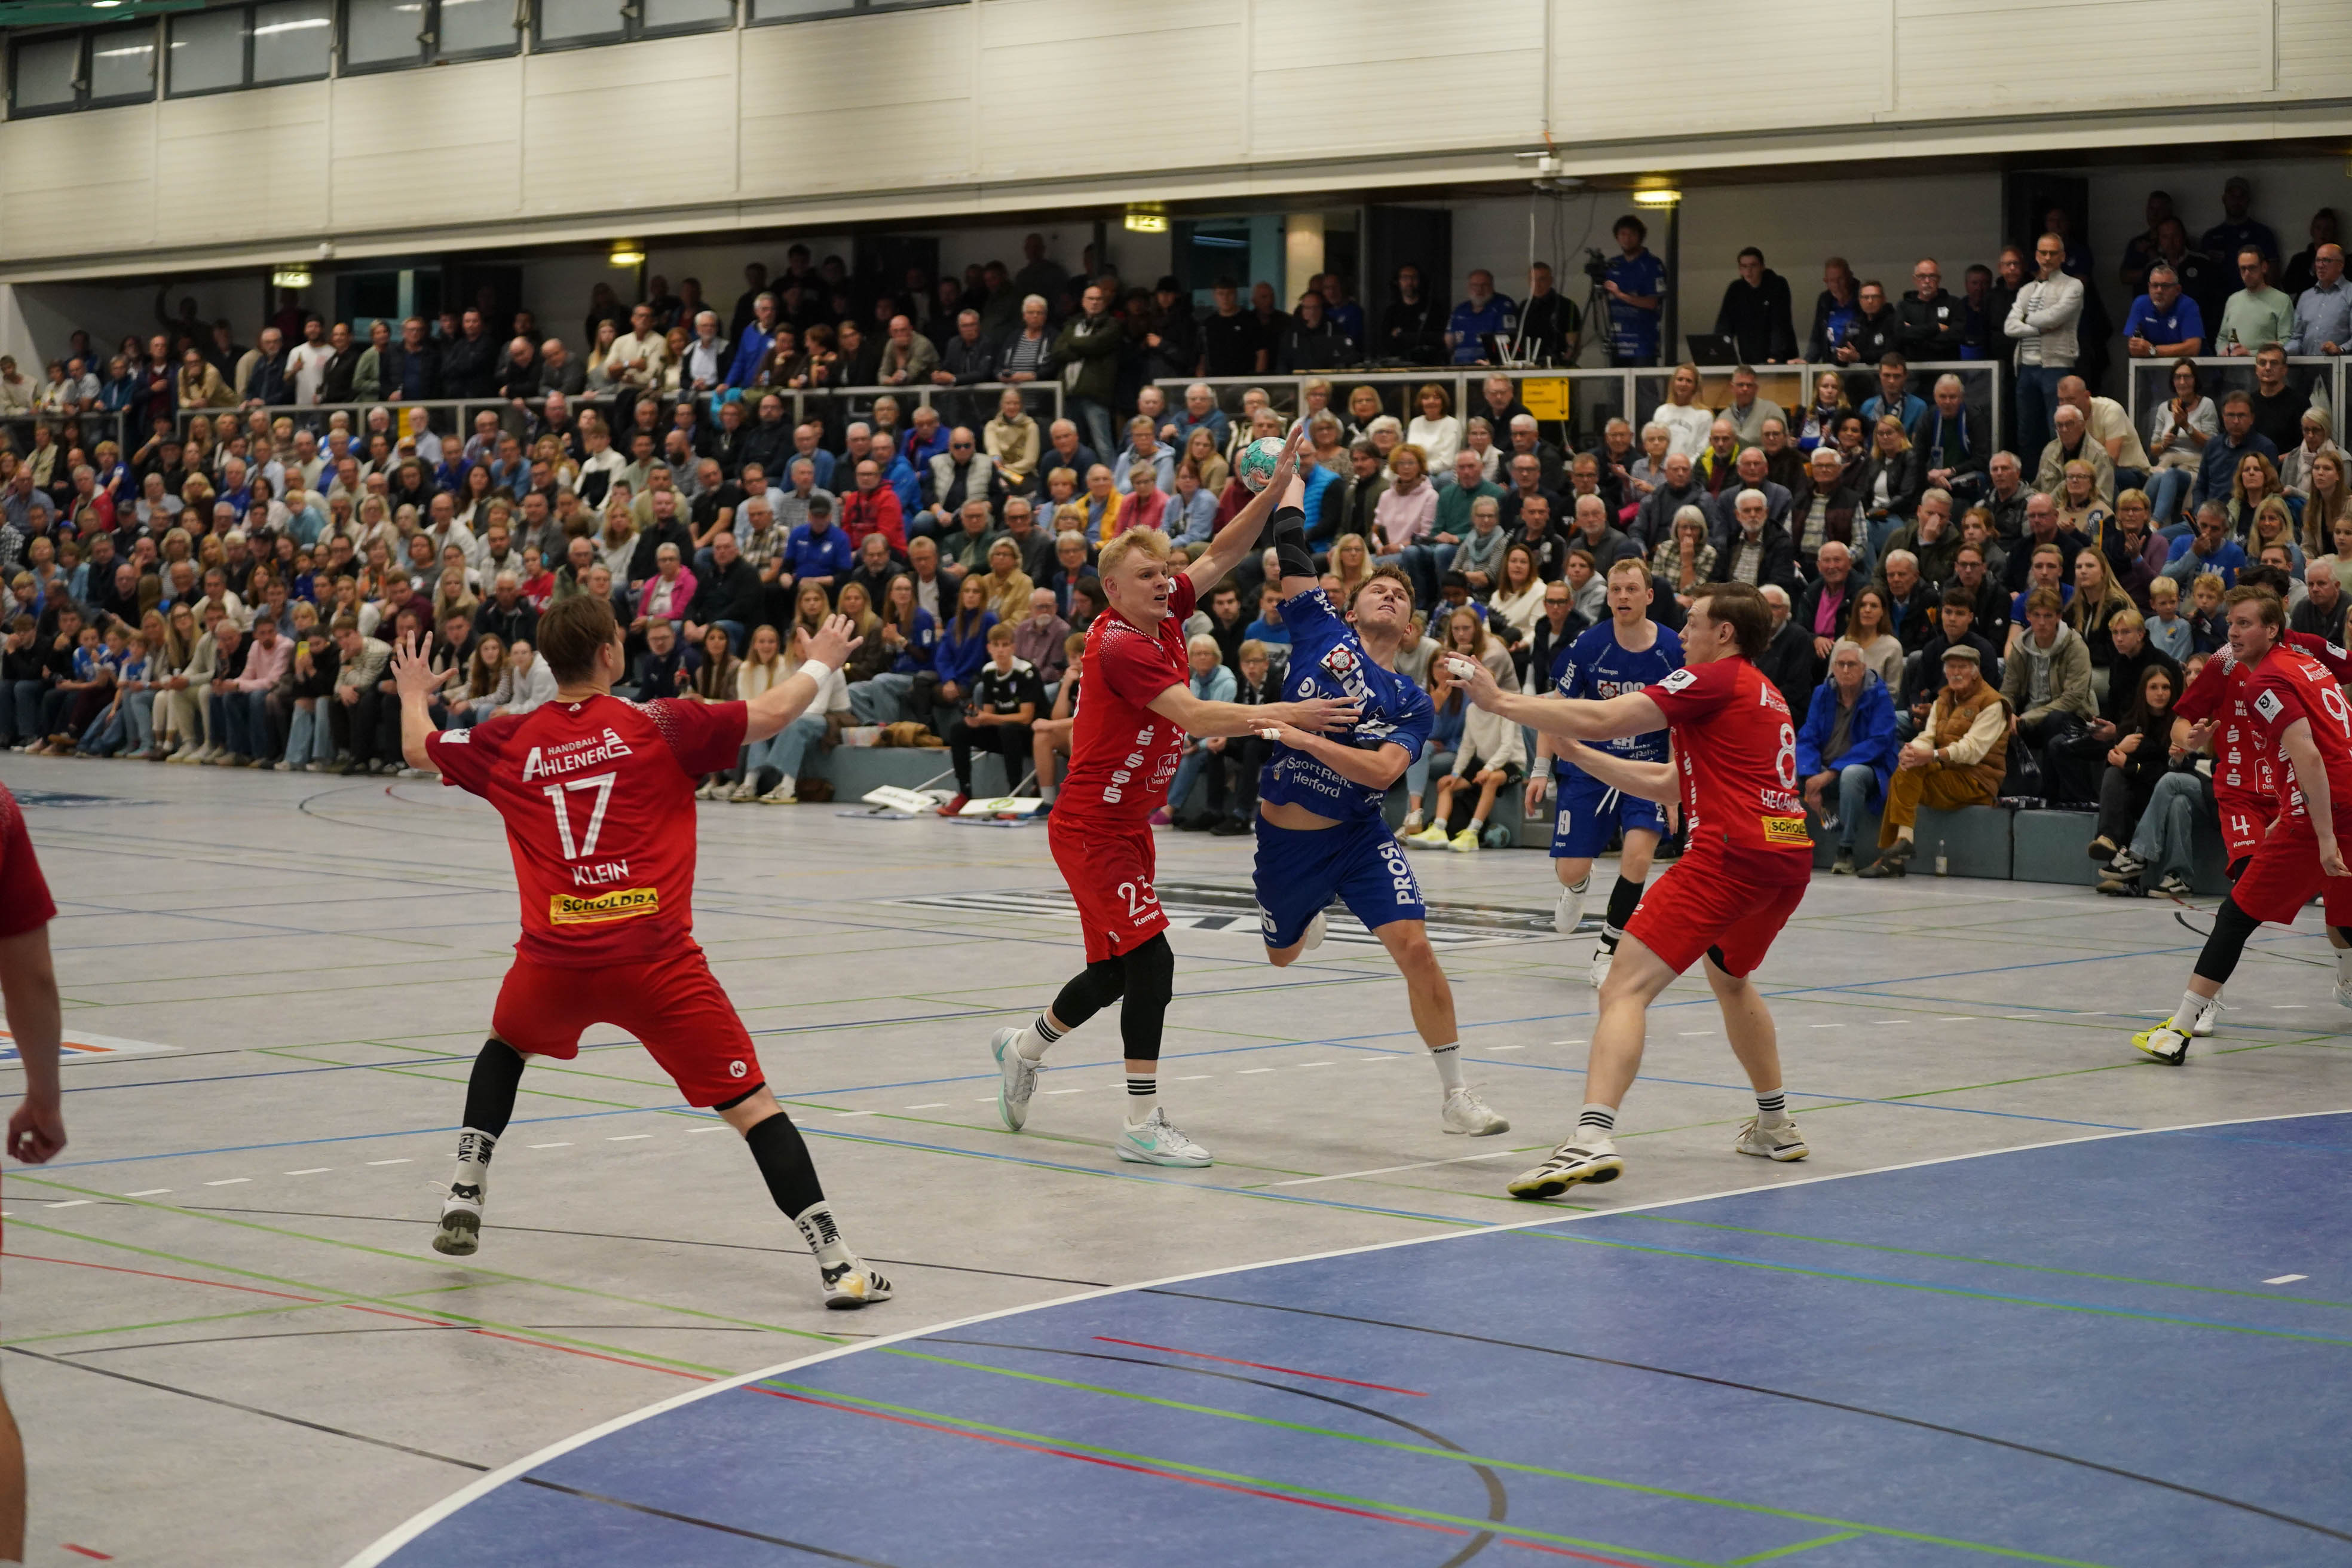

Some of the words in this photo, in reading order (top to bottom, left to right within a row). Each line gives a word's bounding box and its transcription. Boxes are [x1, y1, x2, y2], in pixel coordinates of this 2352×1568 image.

[547, 736, 598, 755] HANDBALL
[1775, 722, 1797, 789] 8
[522, 746, 608, 782] AHLENER
[1293, 771, 1340, 798] Herford
[543, 771, 617, 860] 17
[2232, 815, 2250, 836] 4
[2233, 839, 2255, 849] Kempa
[571, 859, 629, 886] KLEIN
[563, 893, 658, 912] SCHOLDRA
[1117, 874, 1158, 917] 23
[1133, 909, 1160, 927] Kempa
